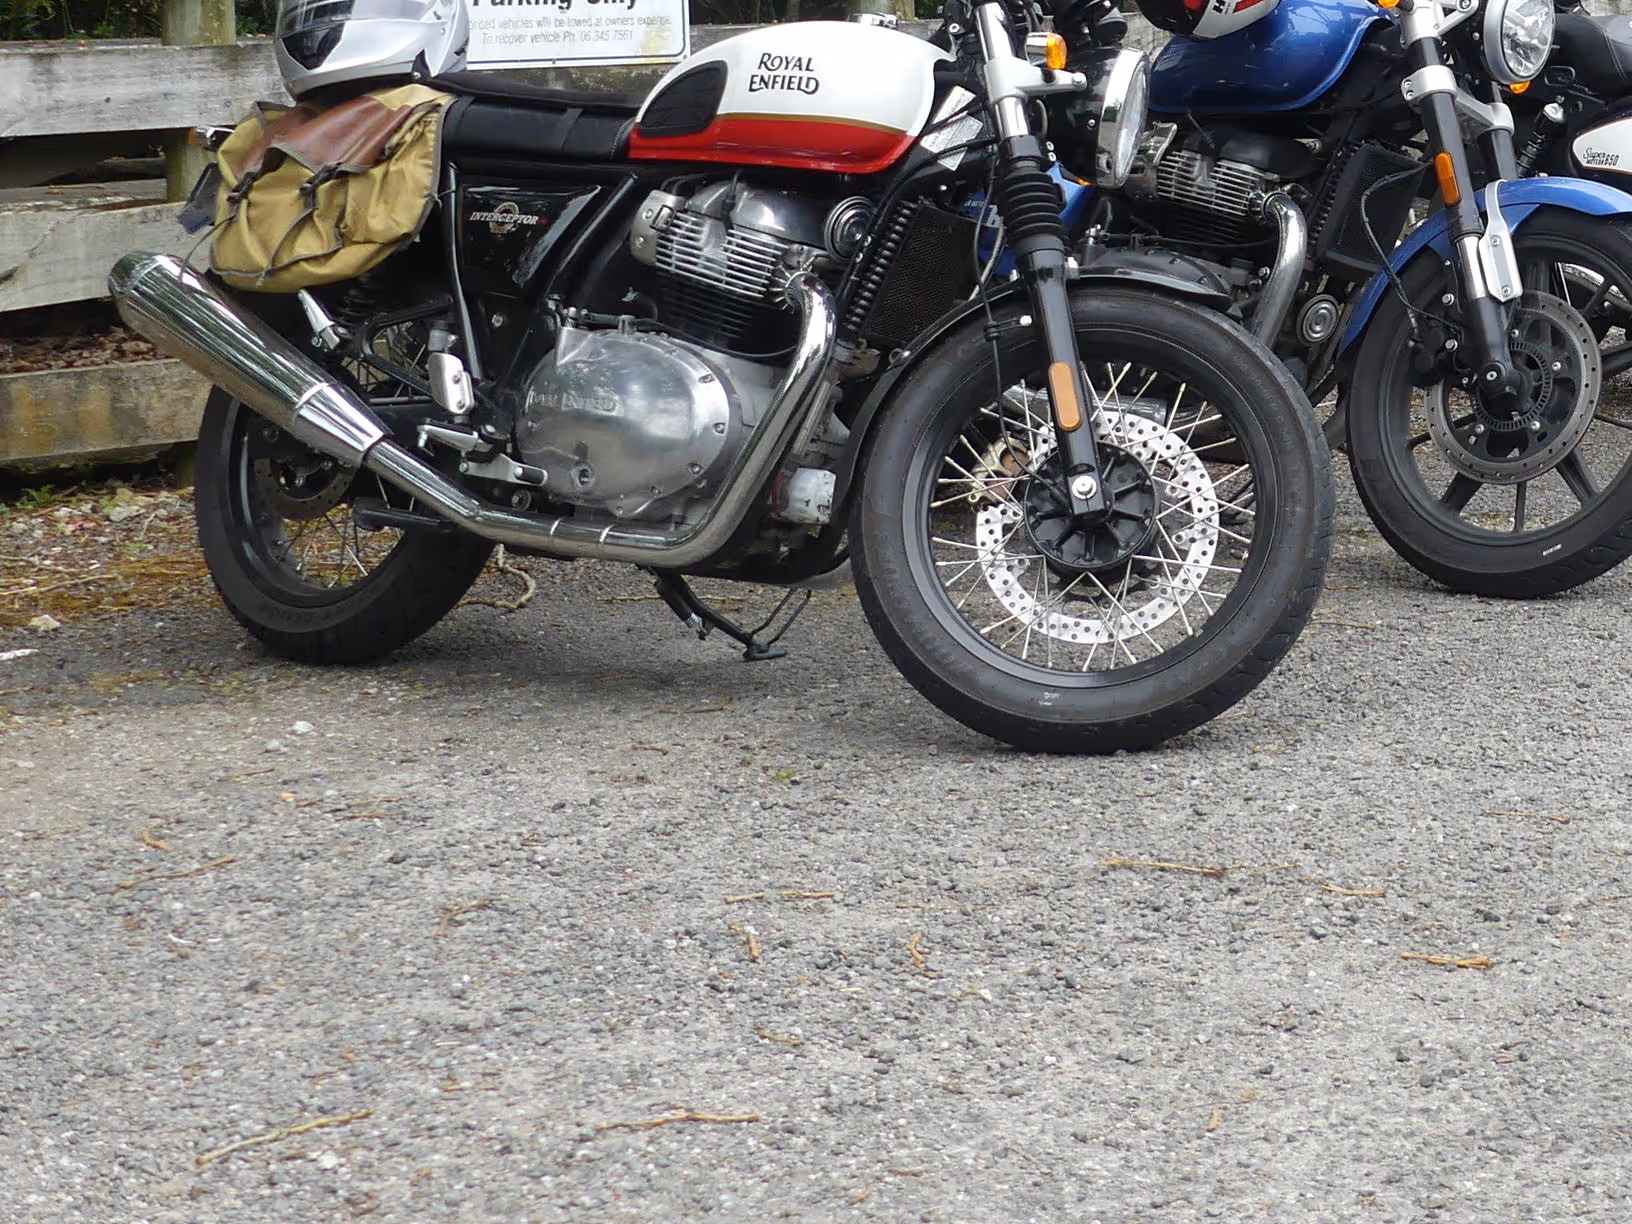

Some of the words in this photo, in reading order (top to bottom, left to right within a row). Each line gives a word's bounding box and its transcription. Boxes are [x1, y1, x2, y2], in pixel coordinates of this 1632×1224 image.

[757, 52, 815, 72] ROYAL
[748, 74, 820, 95] ENFIELD
[469, 212, 539, 225] INTERCEPTOR
